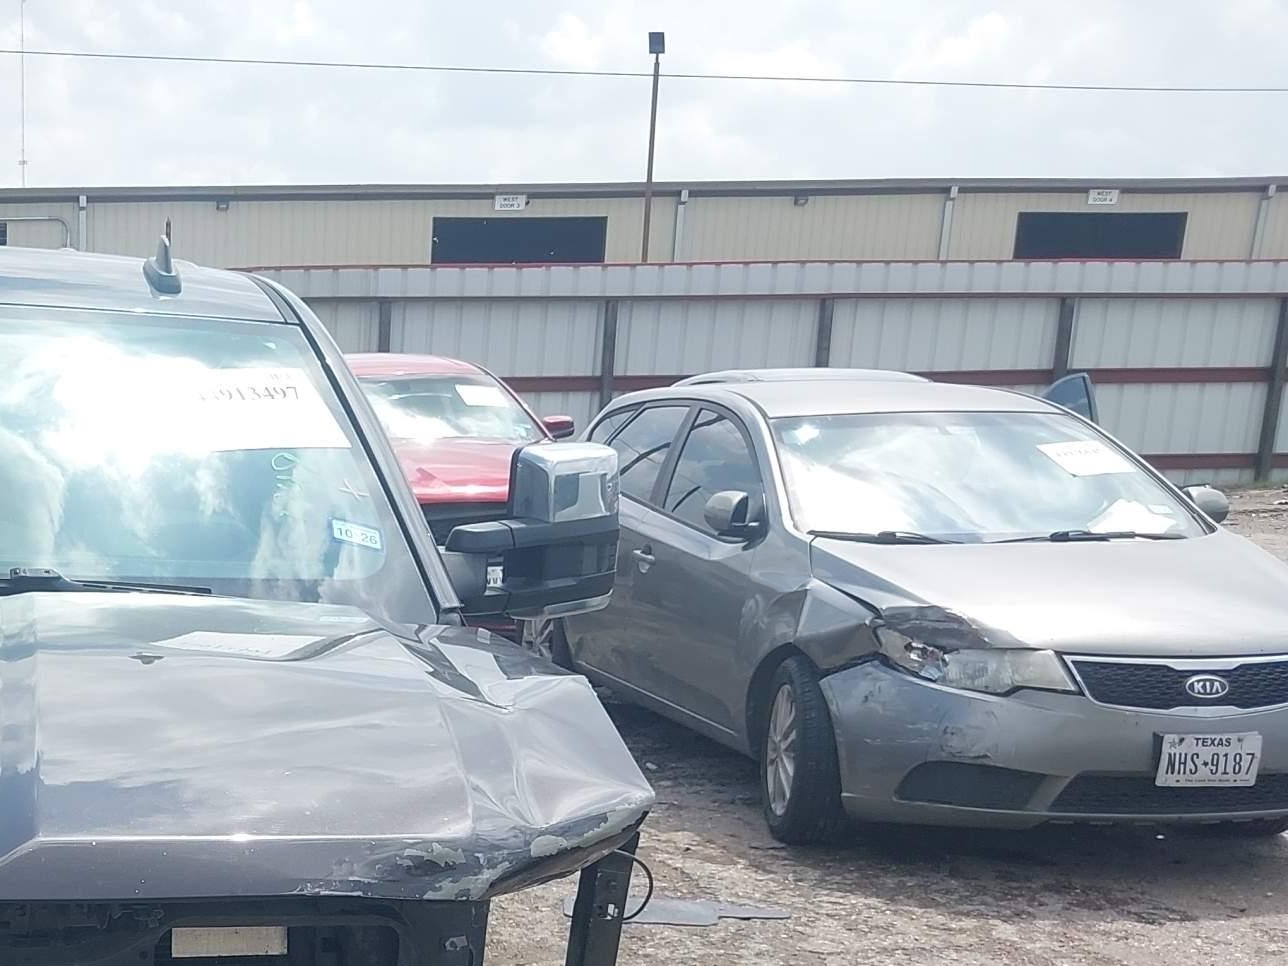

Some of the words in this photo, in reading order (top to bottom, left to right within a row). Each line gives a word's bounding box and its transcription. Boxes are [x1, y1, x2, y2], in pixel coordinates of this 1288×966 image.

[336, 527, 353, 539] 10
[360, 533, 378, 545] 26
[1193, 681, 1222, 694] KIA
[1194, 737, 1232, 748] TEXAS
